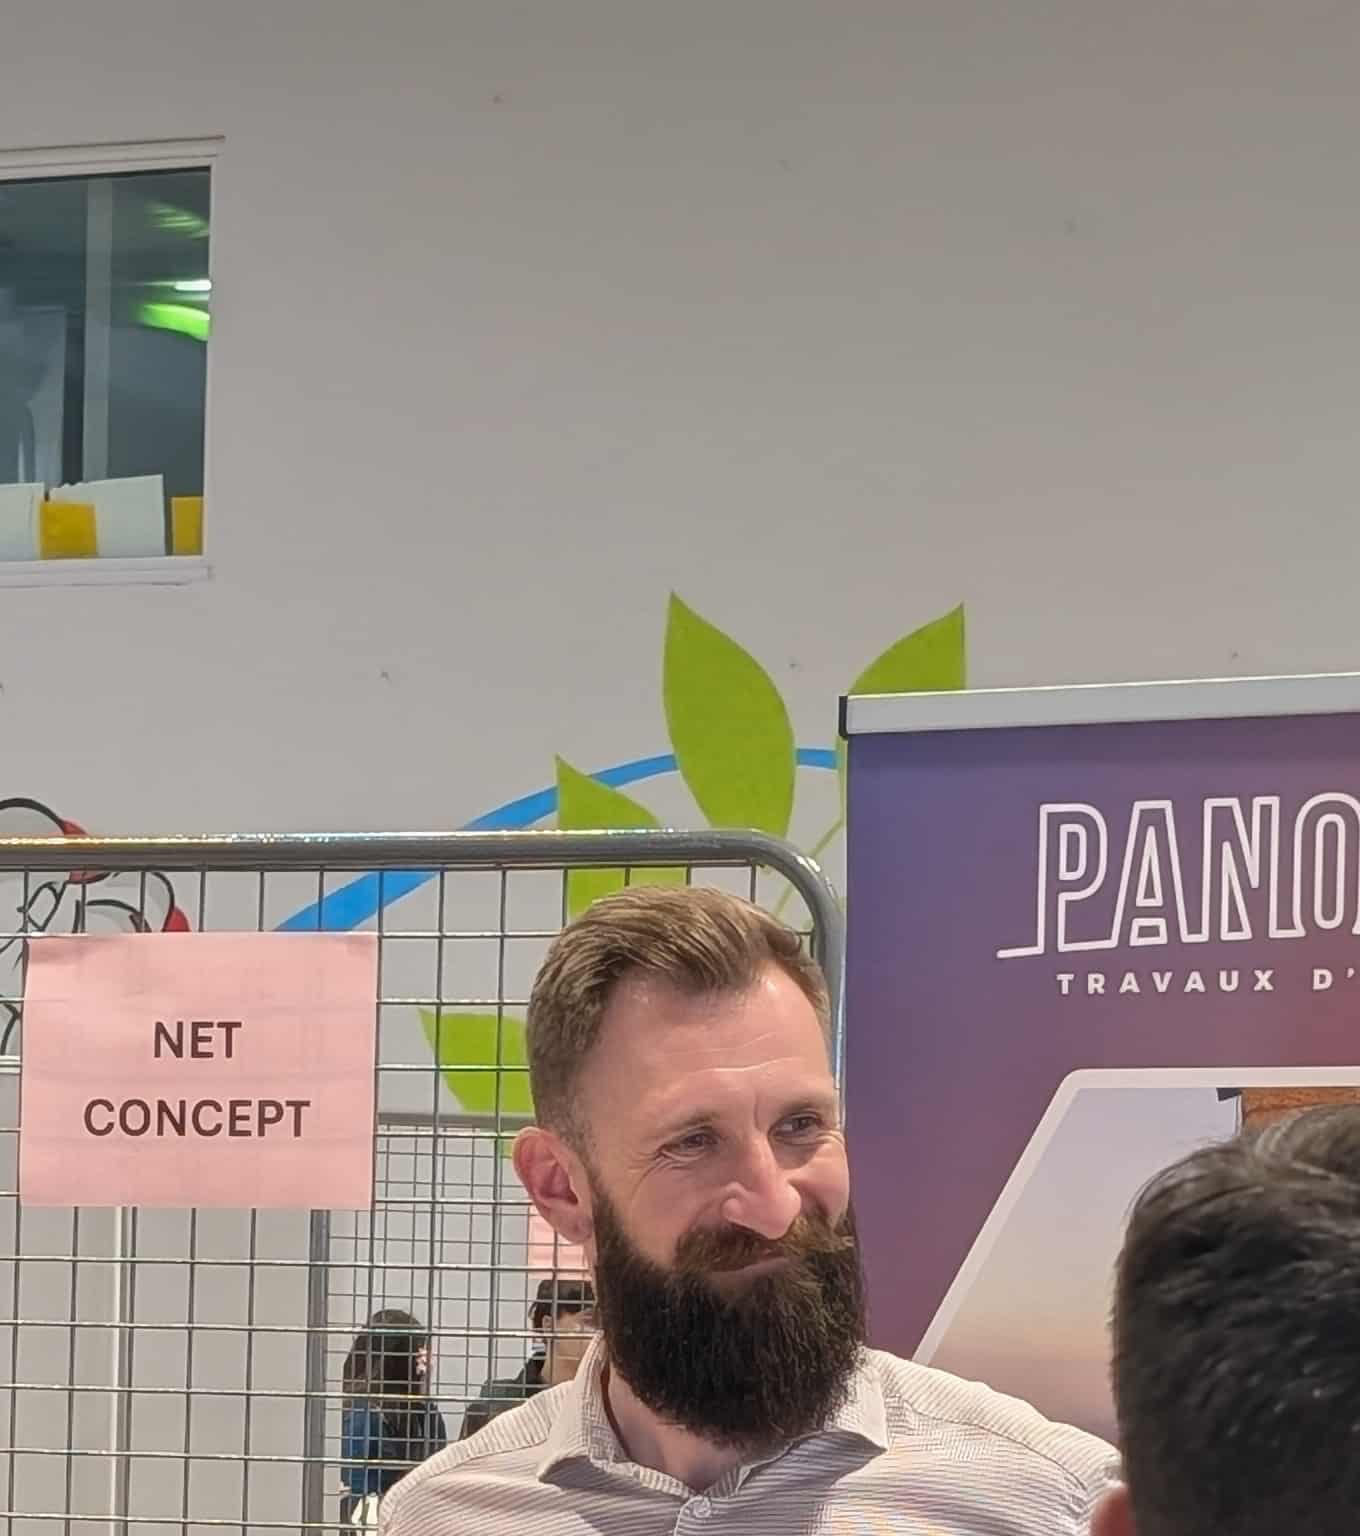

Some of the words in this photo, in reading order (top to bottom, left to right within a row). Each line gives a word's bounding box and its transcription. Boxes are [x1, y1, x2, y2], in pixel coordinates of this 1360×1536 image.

[1056, 969, 1275, 995] TRAVAUX
[153, 1021, 242, 1060] NET
[83, 1098, 311, 1140] CONCEPT
